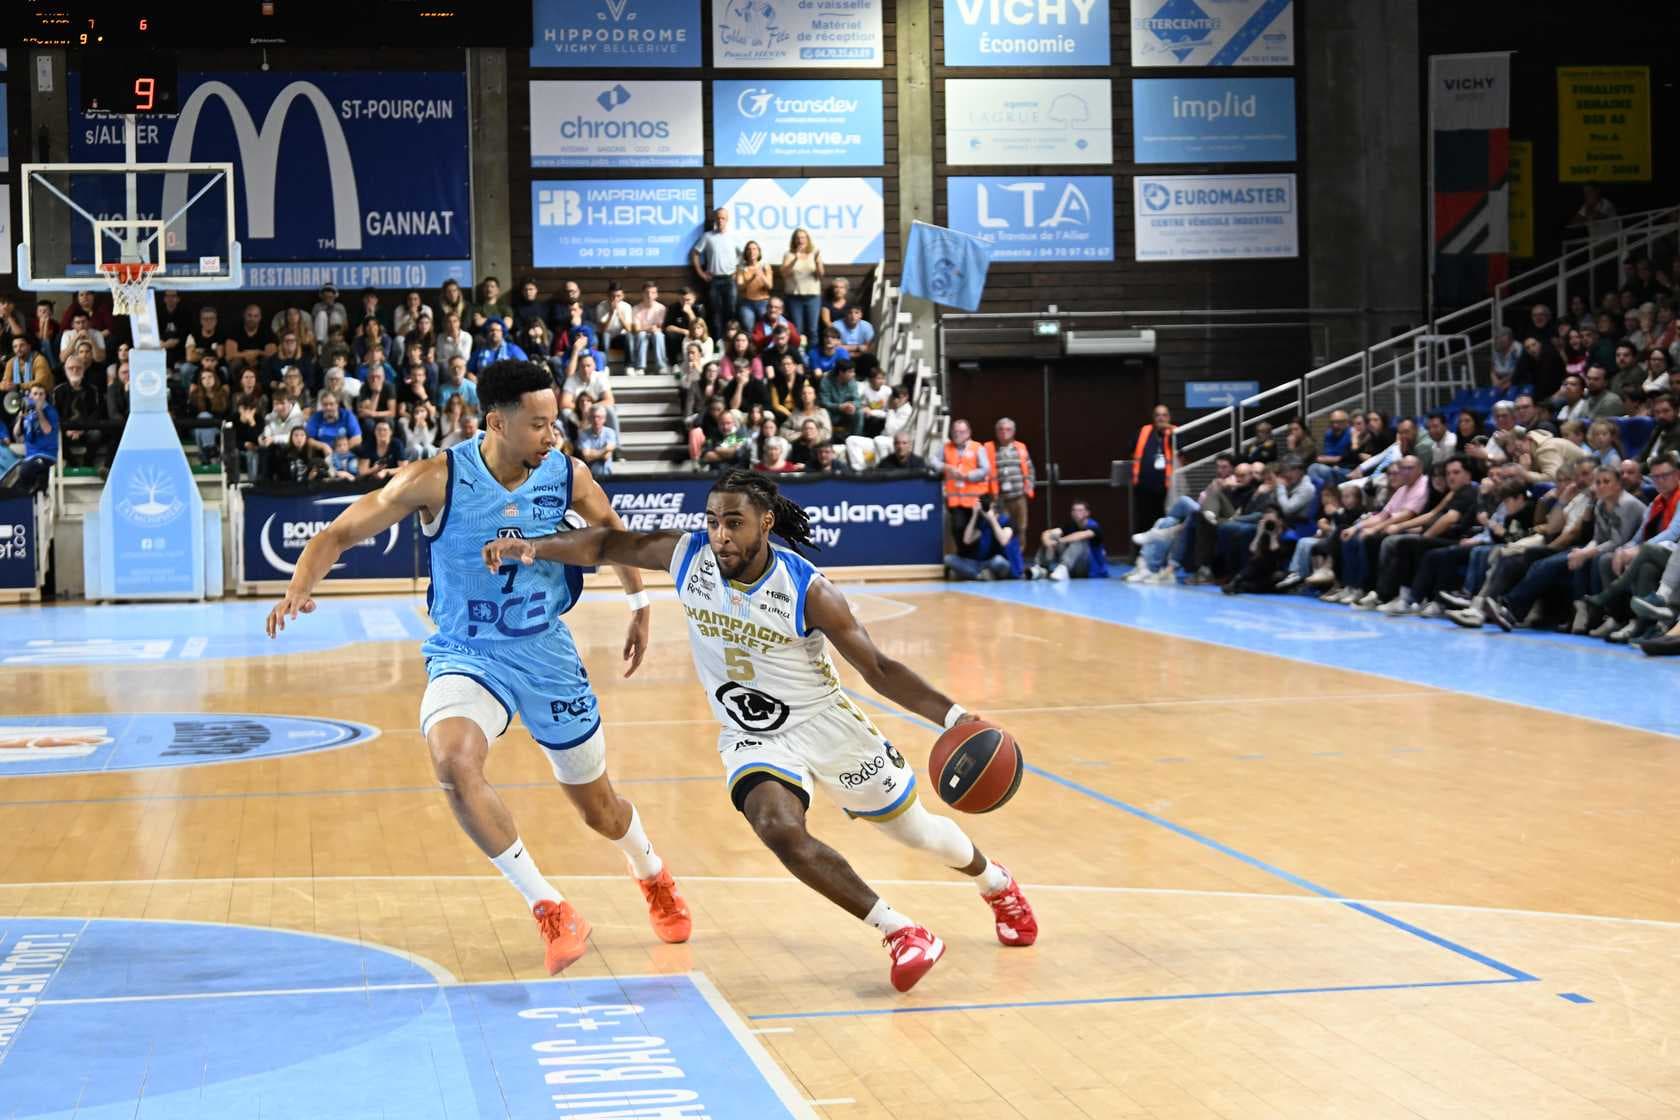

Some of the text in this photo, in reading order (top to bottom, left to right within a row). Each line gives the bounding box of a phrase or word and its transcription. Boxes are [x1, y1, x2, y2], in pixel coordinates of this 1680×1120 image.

[957, 0, 1096, 25] VICHY
[139, 18, 148, 31] 6
[544, 29, 687, 42] HIPPODROME
[79, 33, 88, 45] 9
[797, 31, 875, 43] de réception
[980, 32, 1076, 53] Économie
[555, 44, 678, 53] VICHY BELLERIVE
[135, 78, 155, 110] 9
[1443, 77, 1496, 90] VICHY
[341, 99, 453, 124] ST-POURÇAIN
[775, 97, 857, 113] transdev
[85, 125, 159, 144] s/ALLER
[560, 115, 670, 140] chronos
[587, 189, 697, 201] IMPRIMERIE
[977, 183, 1091, 228] LTA
[1174, 187, 1286, 205] EUROMASTER
[366, 211, 454, 236] GANNAT
[588, 205, 699, 225] H.BRUN
[735, 202, 864, 231] ROUCHY
[250, 266, 339, 288] RESTAURANT
[343, 266, 359, 287] LE
[361, 265, 401, 286] PATIO
[611, 492, 685, 509] FRANCE
[803, 500, 935, 526] oulanger
[497, 564, 519, 594] 7
[697, 623, 775, 655] BASKET
[724, 647, 756, 682] 5
[531, 1035, 686, 1085] BAC
